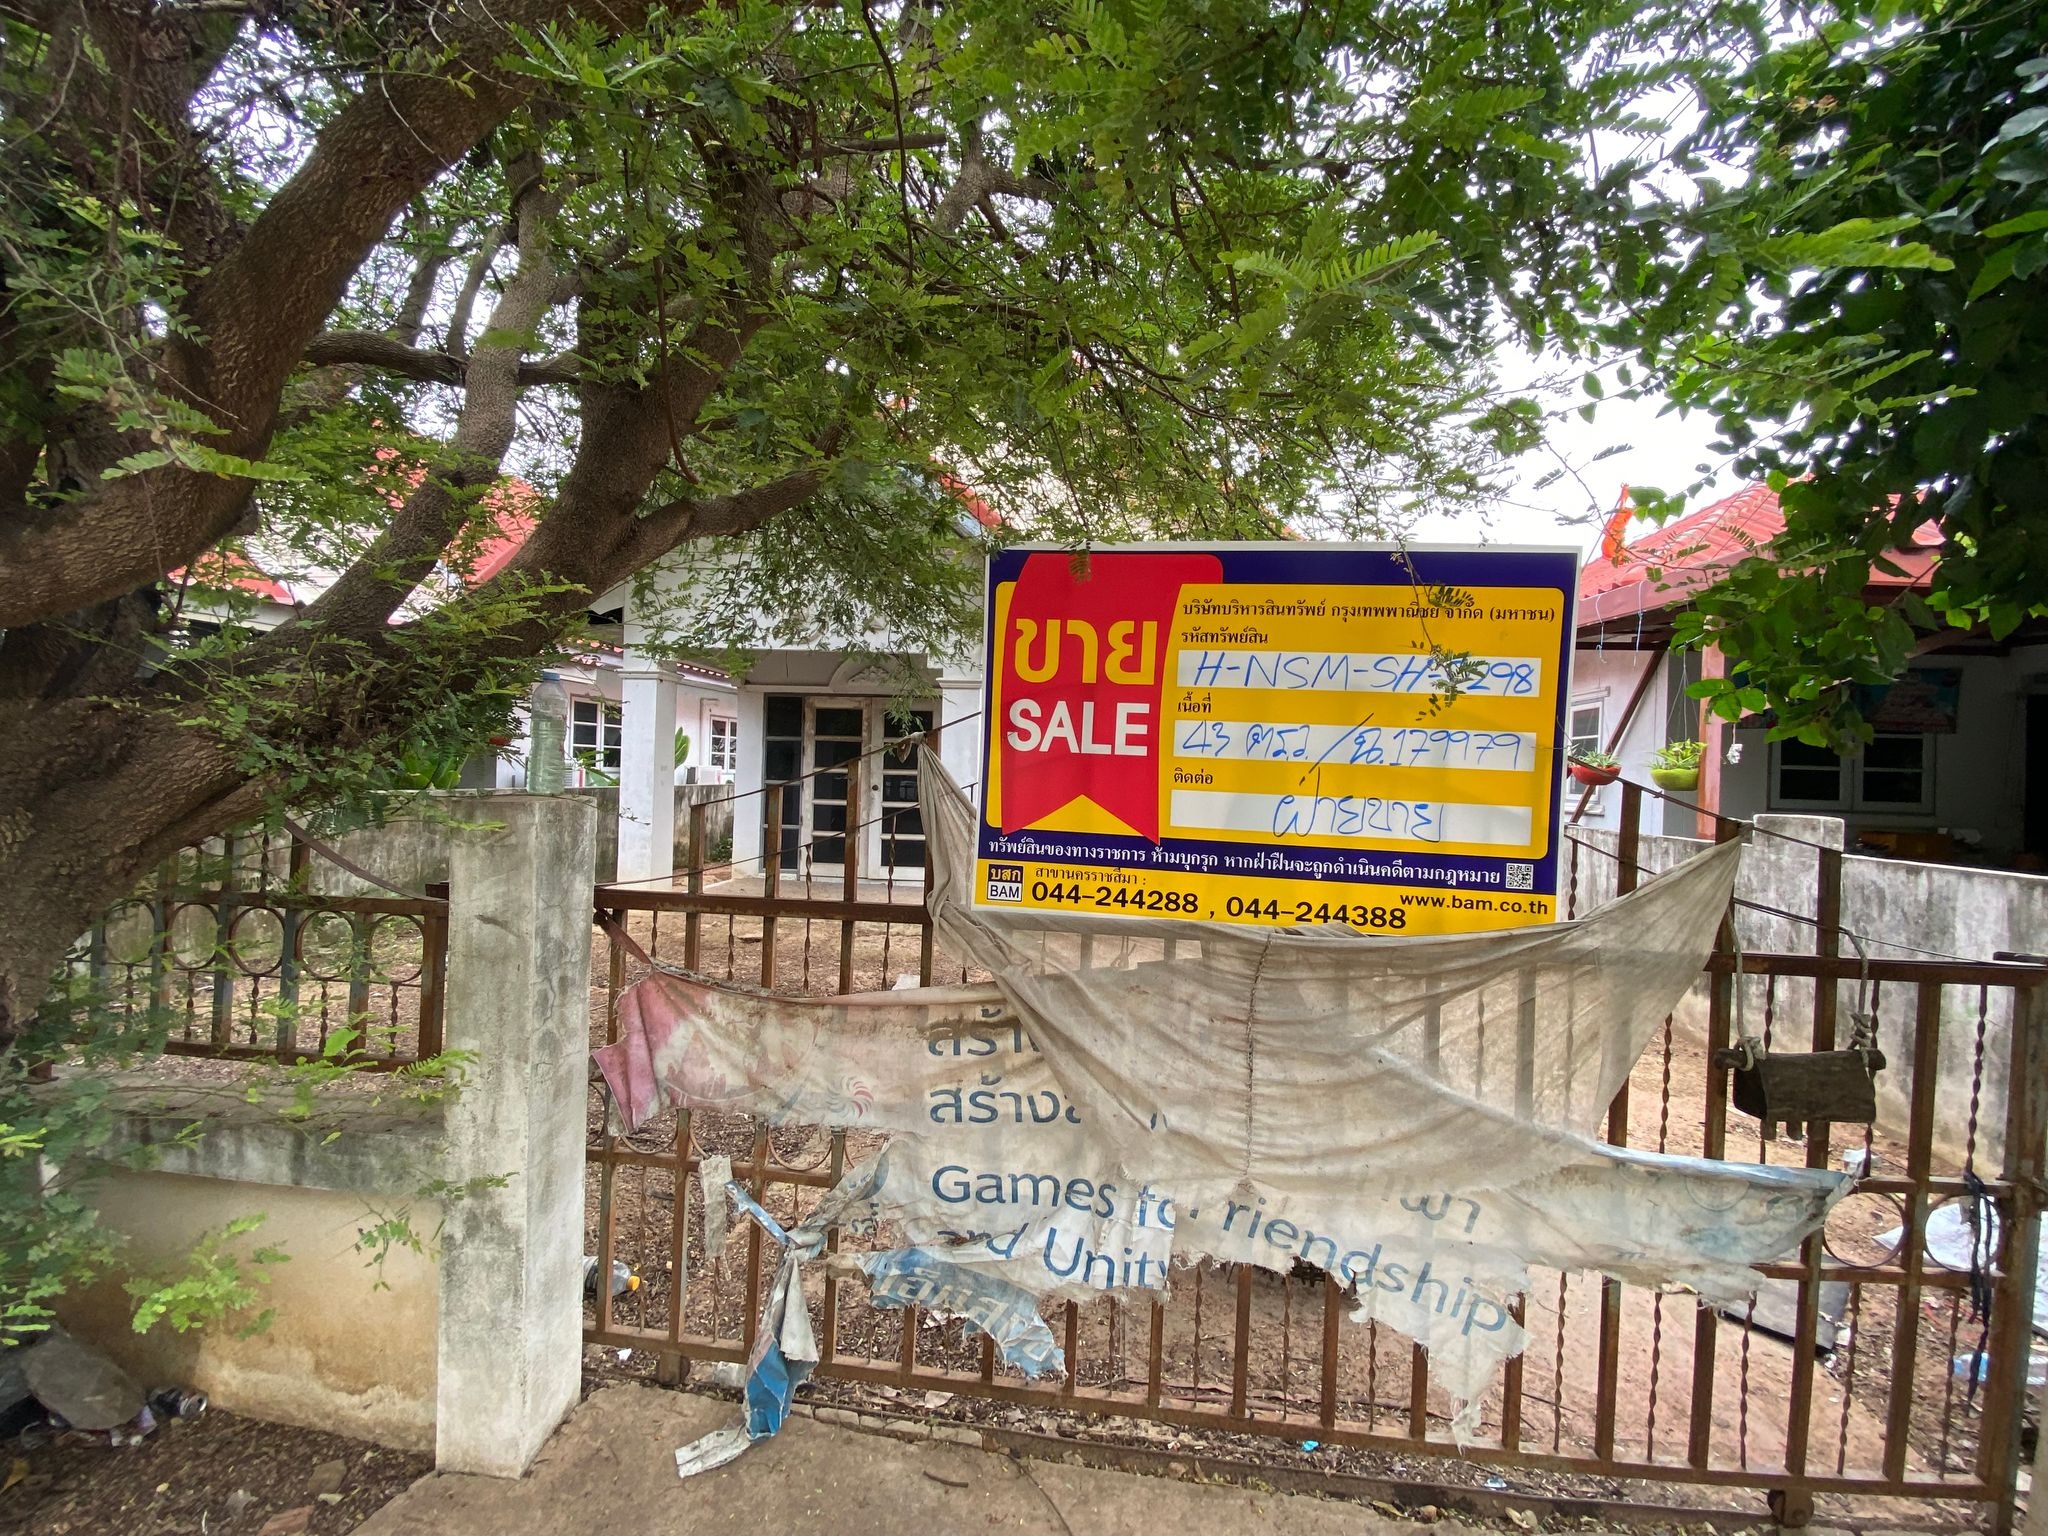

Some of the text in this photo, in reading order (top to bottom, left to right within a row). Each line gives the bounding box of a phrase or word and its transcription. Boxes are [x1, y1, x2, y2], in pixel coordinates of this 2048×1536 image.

[1182, 598, 1326, 617] บริษัทบริหารสินทรัพย์
[1331, 601, 1440, 622] กรุงเทพพาณิชย
[1489, 607, 1555, 622] (มหาชน)
[1181, 626, 1269, 644] รหัสทรัพย์สิน
[1014, 618, 1158, 686] ขาย
[1194, 650, 1535, 696] H-NSM-SH-298
[1177, 691, 1212, 713] เนื้อที่
[1007, 698, 1150, 757] SALE
[1182, 720, 1231, 757] 43
[1174, 767, 1213, 784] ติดต่อ
[988, 836, 1146, 862] ทรัพย์สินของทางราชการ
[1151, 846, 1218, 871] ห้ามบุกรุก
[990, 867, 1022, 882] บสก
[989, 884, 1020, 899] BAM
[1031, 881, 1199, 914] 044-244288
[1226, 896, 1407, 929] 044-244388
[1400, 894, 1548, 916] www.bam.co.th
[931, 1164, 1117, 1219] Games
[1190, 1196, 1507, 1336] riendship
